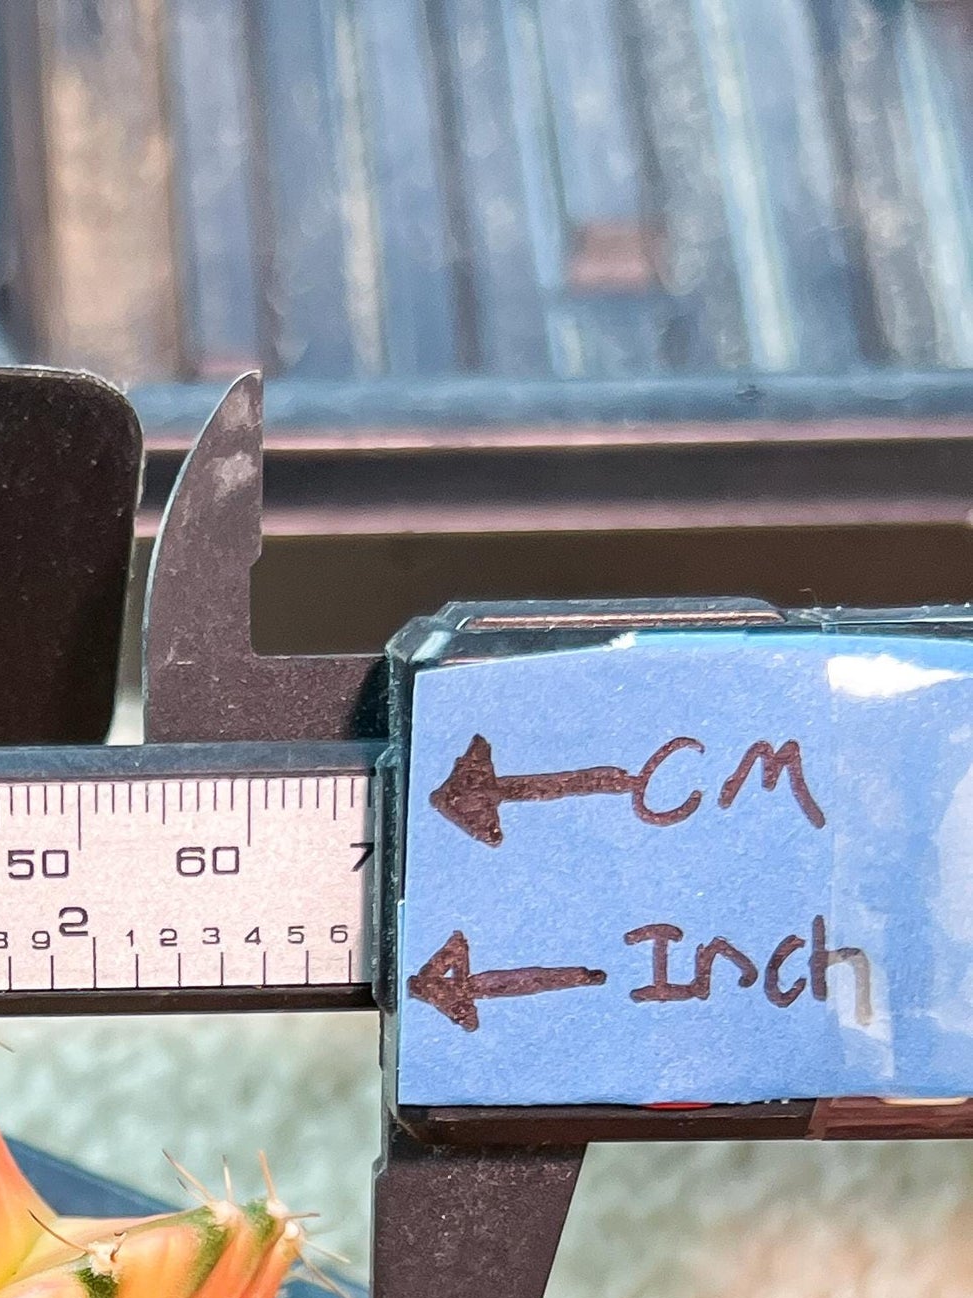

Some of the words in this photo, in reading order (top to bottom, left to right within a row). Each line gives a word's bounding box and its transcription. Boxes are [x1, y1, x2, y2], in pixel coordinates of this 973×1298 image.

[8, 850, 69, 880] 50
[177, 846, 239, 877] 60
[31, 930, 51, 951] 9
[58, 906, 89, 937] 2
[125, 929, 134, 947] 1
[159, 927, 178, 947] 2
[202, 926, 221, 945] 3
[244, 926, 262, 946] 4
[287, 925, 305, 945] 5
[330, 924, 349, 944] 6
[624, 914, 872, 1026] Inch
